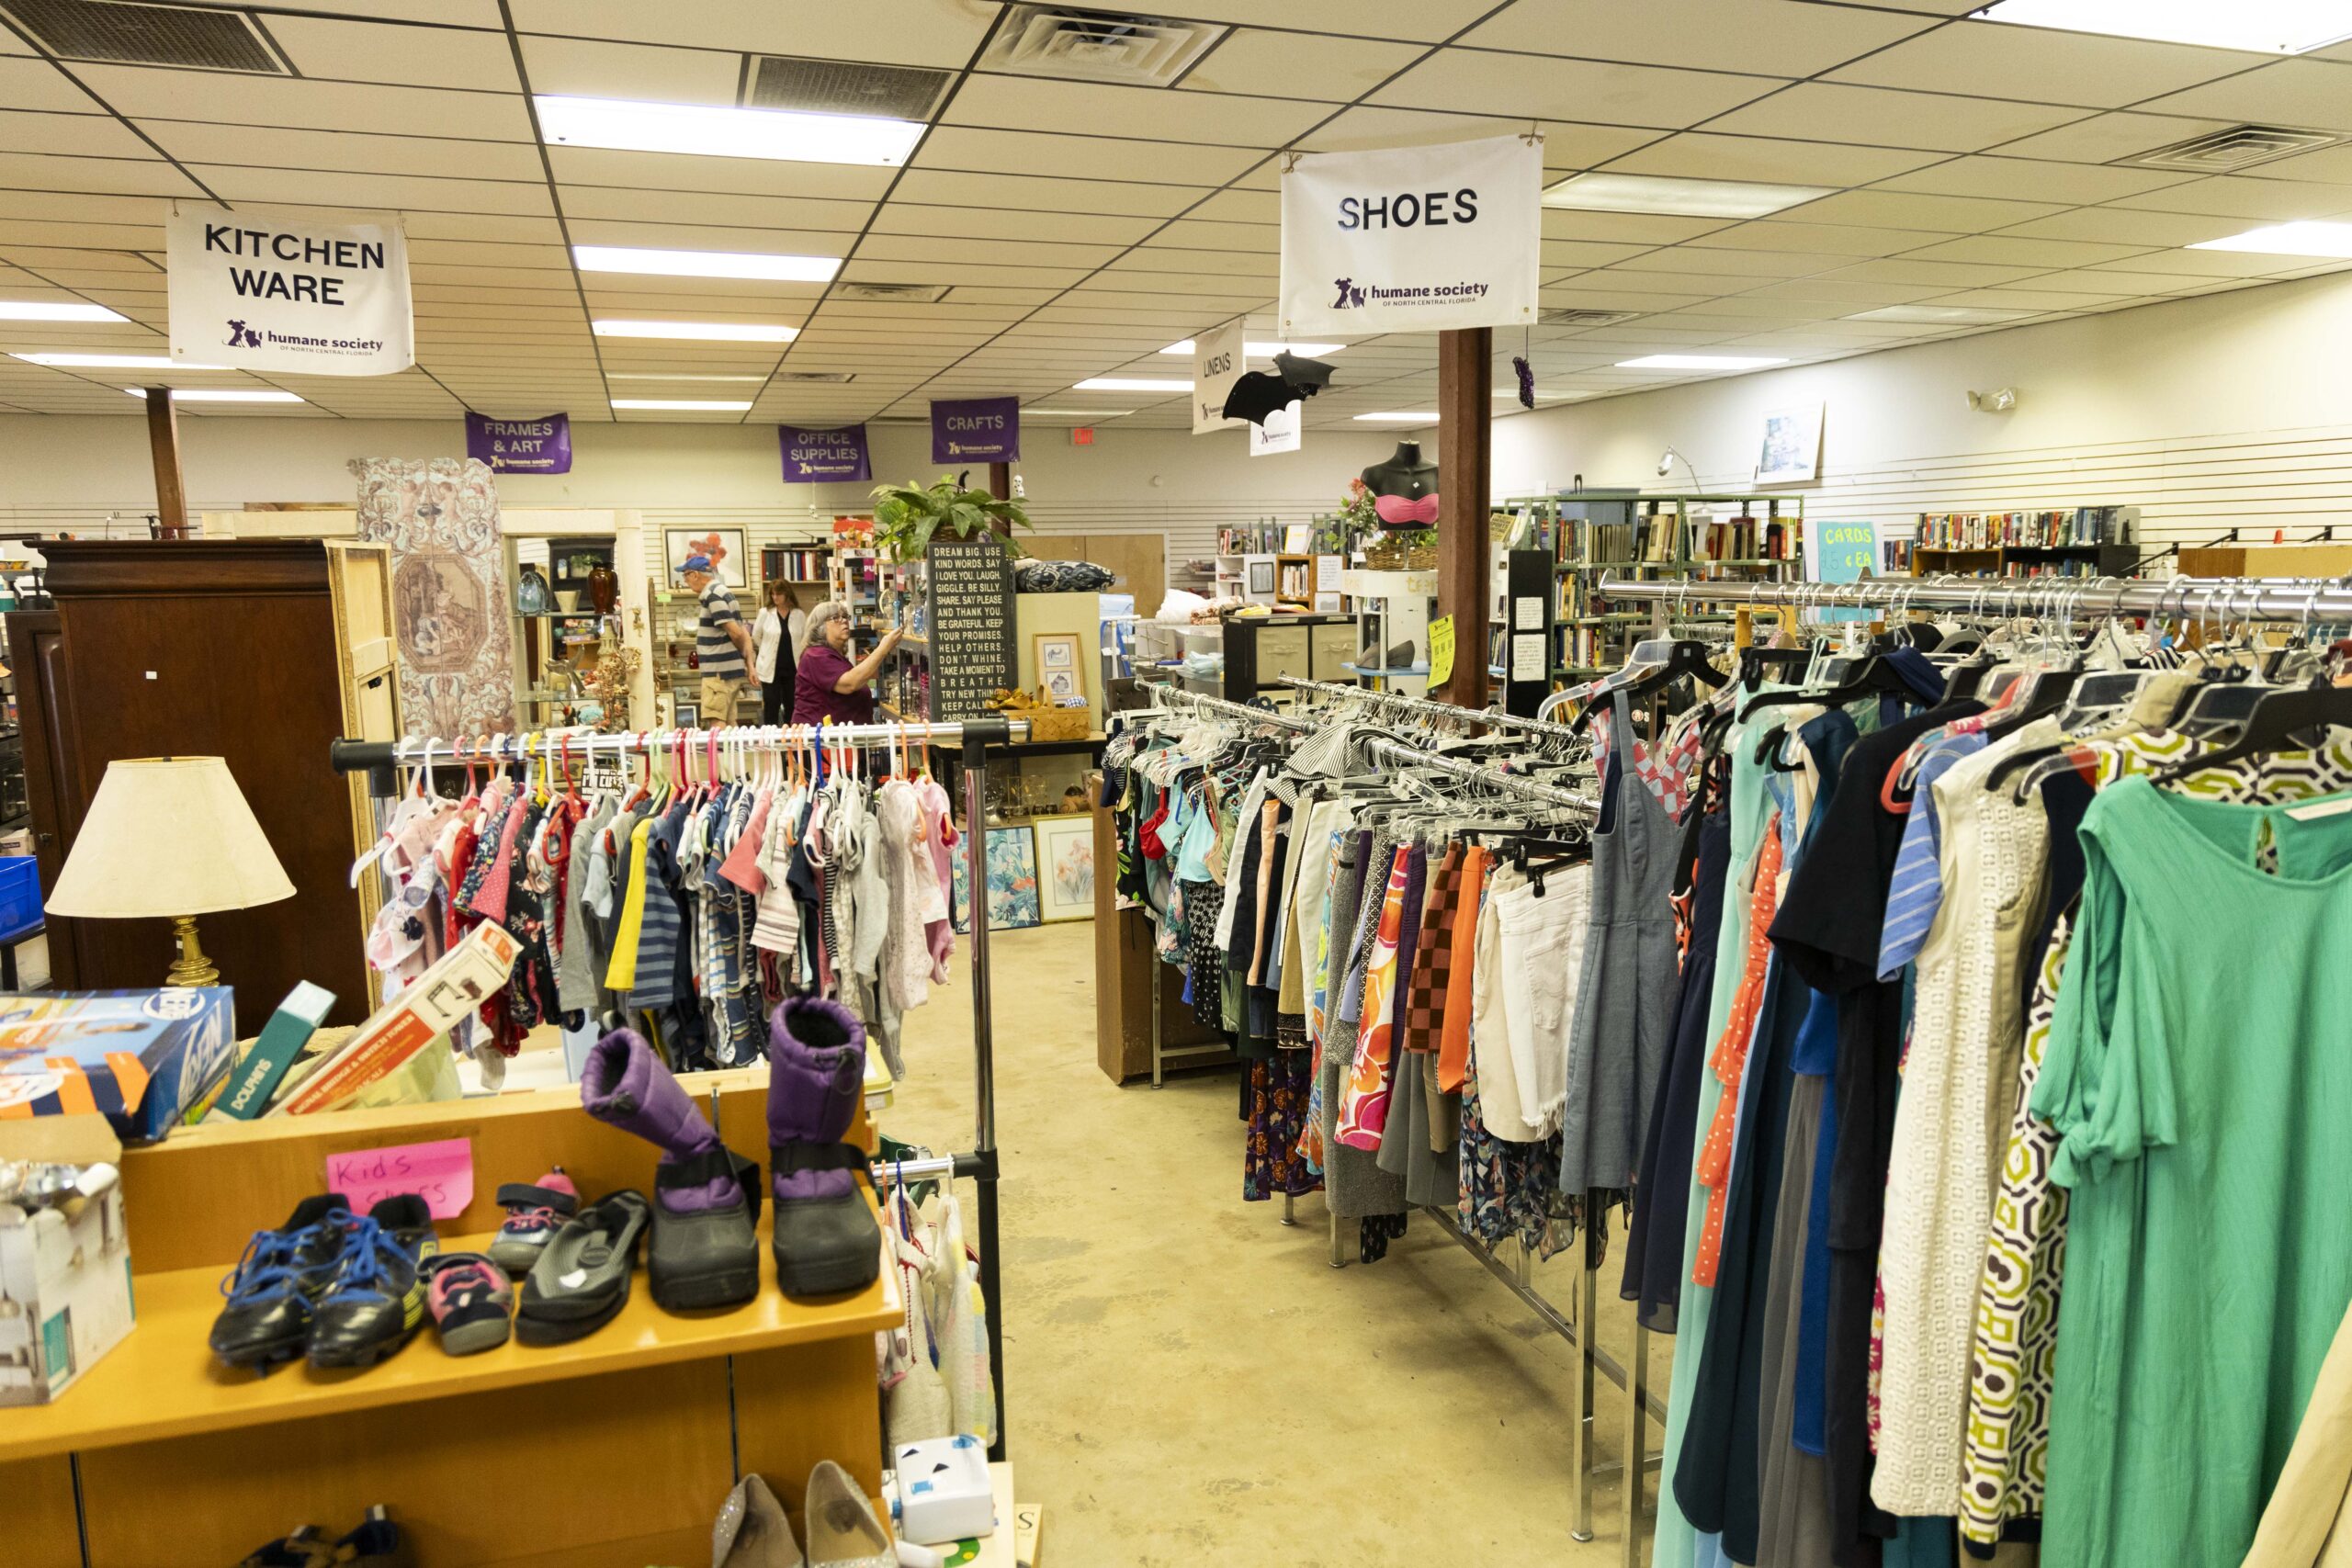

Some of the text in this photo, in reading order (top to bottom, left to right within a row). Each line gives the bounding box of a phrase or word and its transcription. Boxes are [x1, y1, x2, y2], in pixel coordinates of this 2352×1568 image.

[1337, 188, 1478, 231] SHOES
[205, 223, 385, 269] KITCHEN
[229, 266, 345, 306] WARE
[1372, 282, 1488, 299] humane society
[268, 331, 383, 352] humane society
[1203, 352, 1231, 378] LINENS
[946, 415, 1004, 430] CRAFTS
[484, 423, 553, 436] FRAMES
[797, 433, 851, 445] OFFICE
[493, 440, 543, 453] & ART
[790, 447, 858, 461] SUPPLIES
[1825, 527, 1872, 544] CARDS
[934, 547, 1001, 557] DREAM BIG. USE
[955, 559, 983, 568] WORDS.
[986, 559, 1001, 568] SAY
[939, 571, 957, 580] LOVE
[959, 571, 974, 580] YOU.
[977, 571, 1001, 580] LAUGH.
[936, 583, 966, 592] GIGGLE.
[979, 583, 1001, 592] SILLY.
[937, 595, 1001, 604] SHARE. SAY PLEASE
[937, 607, 1002, 616] AND THANK YOU.
[938, 619, 1002, 629] BE GRATEFUL. KEEP
[939, 631, 1003, 640] YOUR PROMISES.
[939, 643, 1004, 652] HELP OTHERS.
[940, 654, 1005, 663] DON'T WHINE.
[940, 667, 958, 675] TAKE
[967, 666, 994, 674] MOMENT
[996, 665, 1005, 673] TO
[942, 689, 999, 699] TRY NEW THIN
[942, 702, 962, 711] KEEP
[322, 1068, 350, 1092] BRIDGE
[351, 1060, 359, 1068] &
[358, 1038, 387, 1062] SWITCH
[387, 1014, 414, 1039] TOWER
[231, 1058, 272, 1111] DOLPHINS
[336, 1156, 411, 1185] Kids
[1018, 1512, 1035, 1529] S
